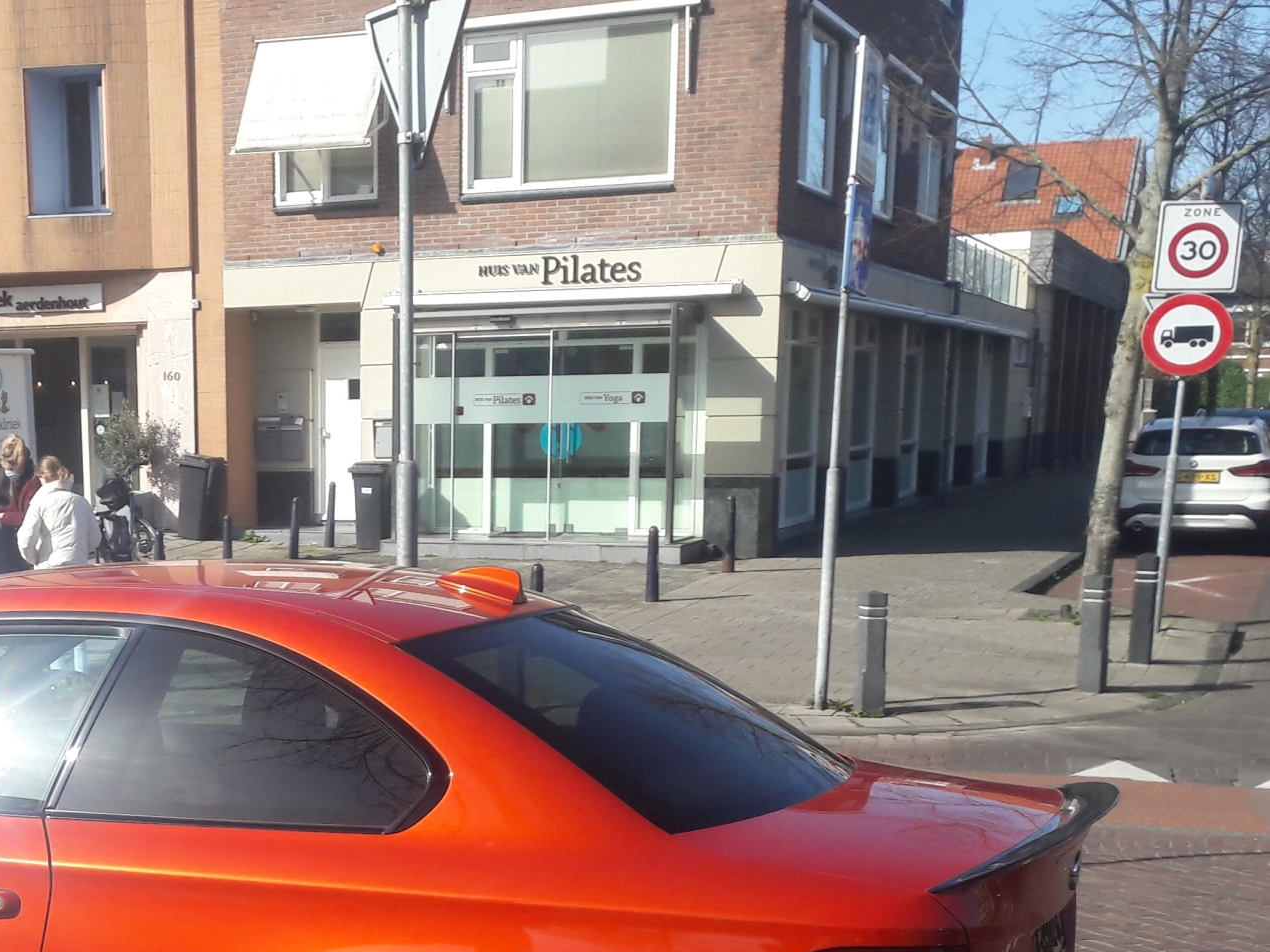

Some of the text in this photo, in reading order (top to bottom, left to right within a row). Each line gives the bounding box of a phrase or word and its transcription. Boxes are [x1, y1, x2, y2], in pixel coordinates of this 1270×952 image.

[1183, 208, 1222, 217] ZONE
[1180, 240, 1217, 261] 30
[478, 254, 642, 286] HUIS VAN Pilates
[16, 295, 90, 312] aerdenhout
[163, 371, 181, 381] 160
[493, 395, 521, 405] Pilates
[603, 394, 623, 404] Yoga
